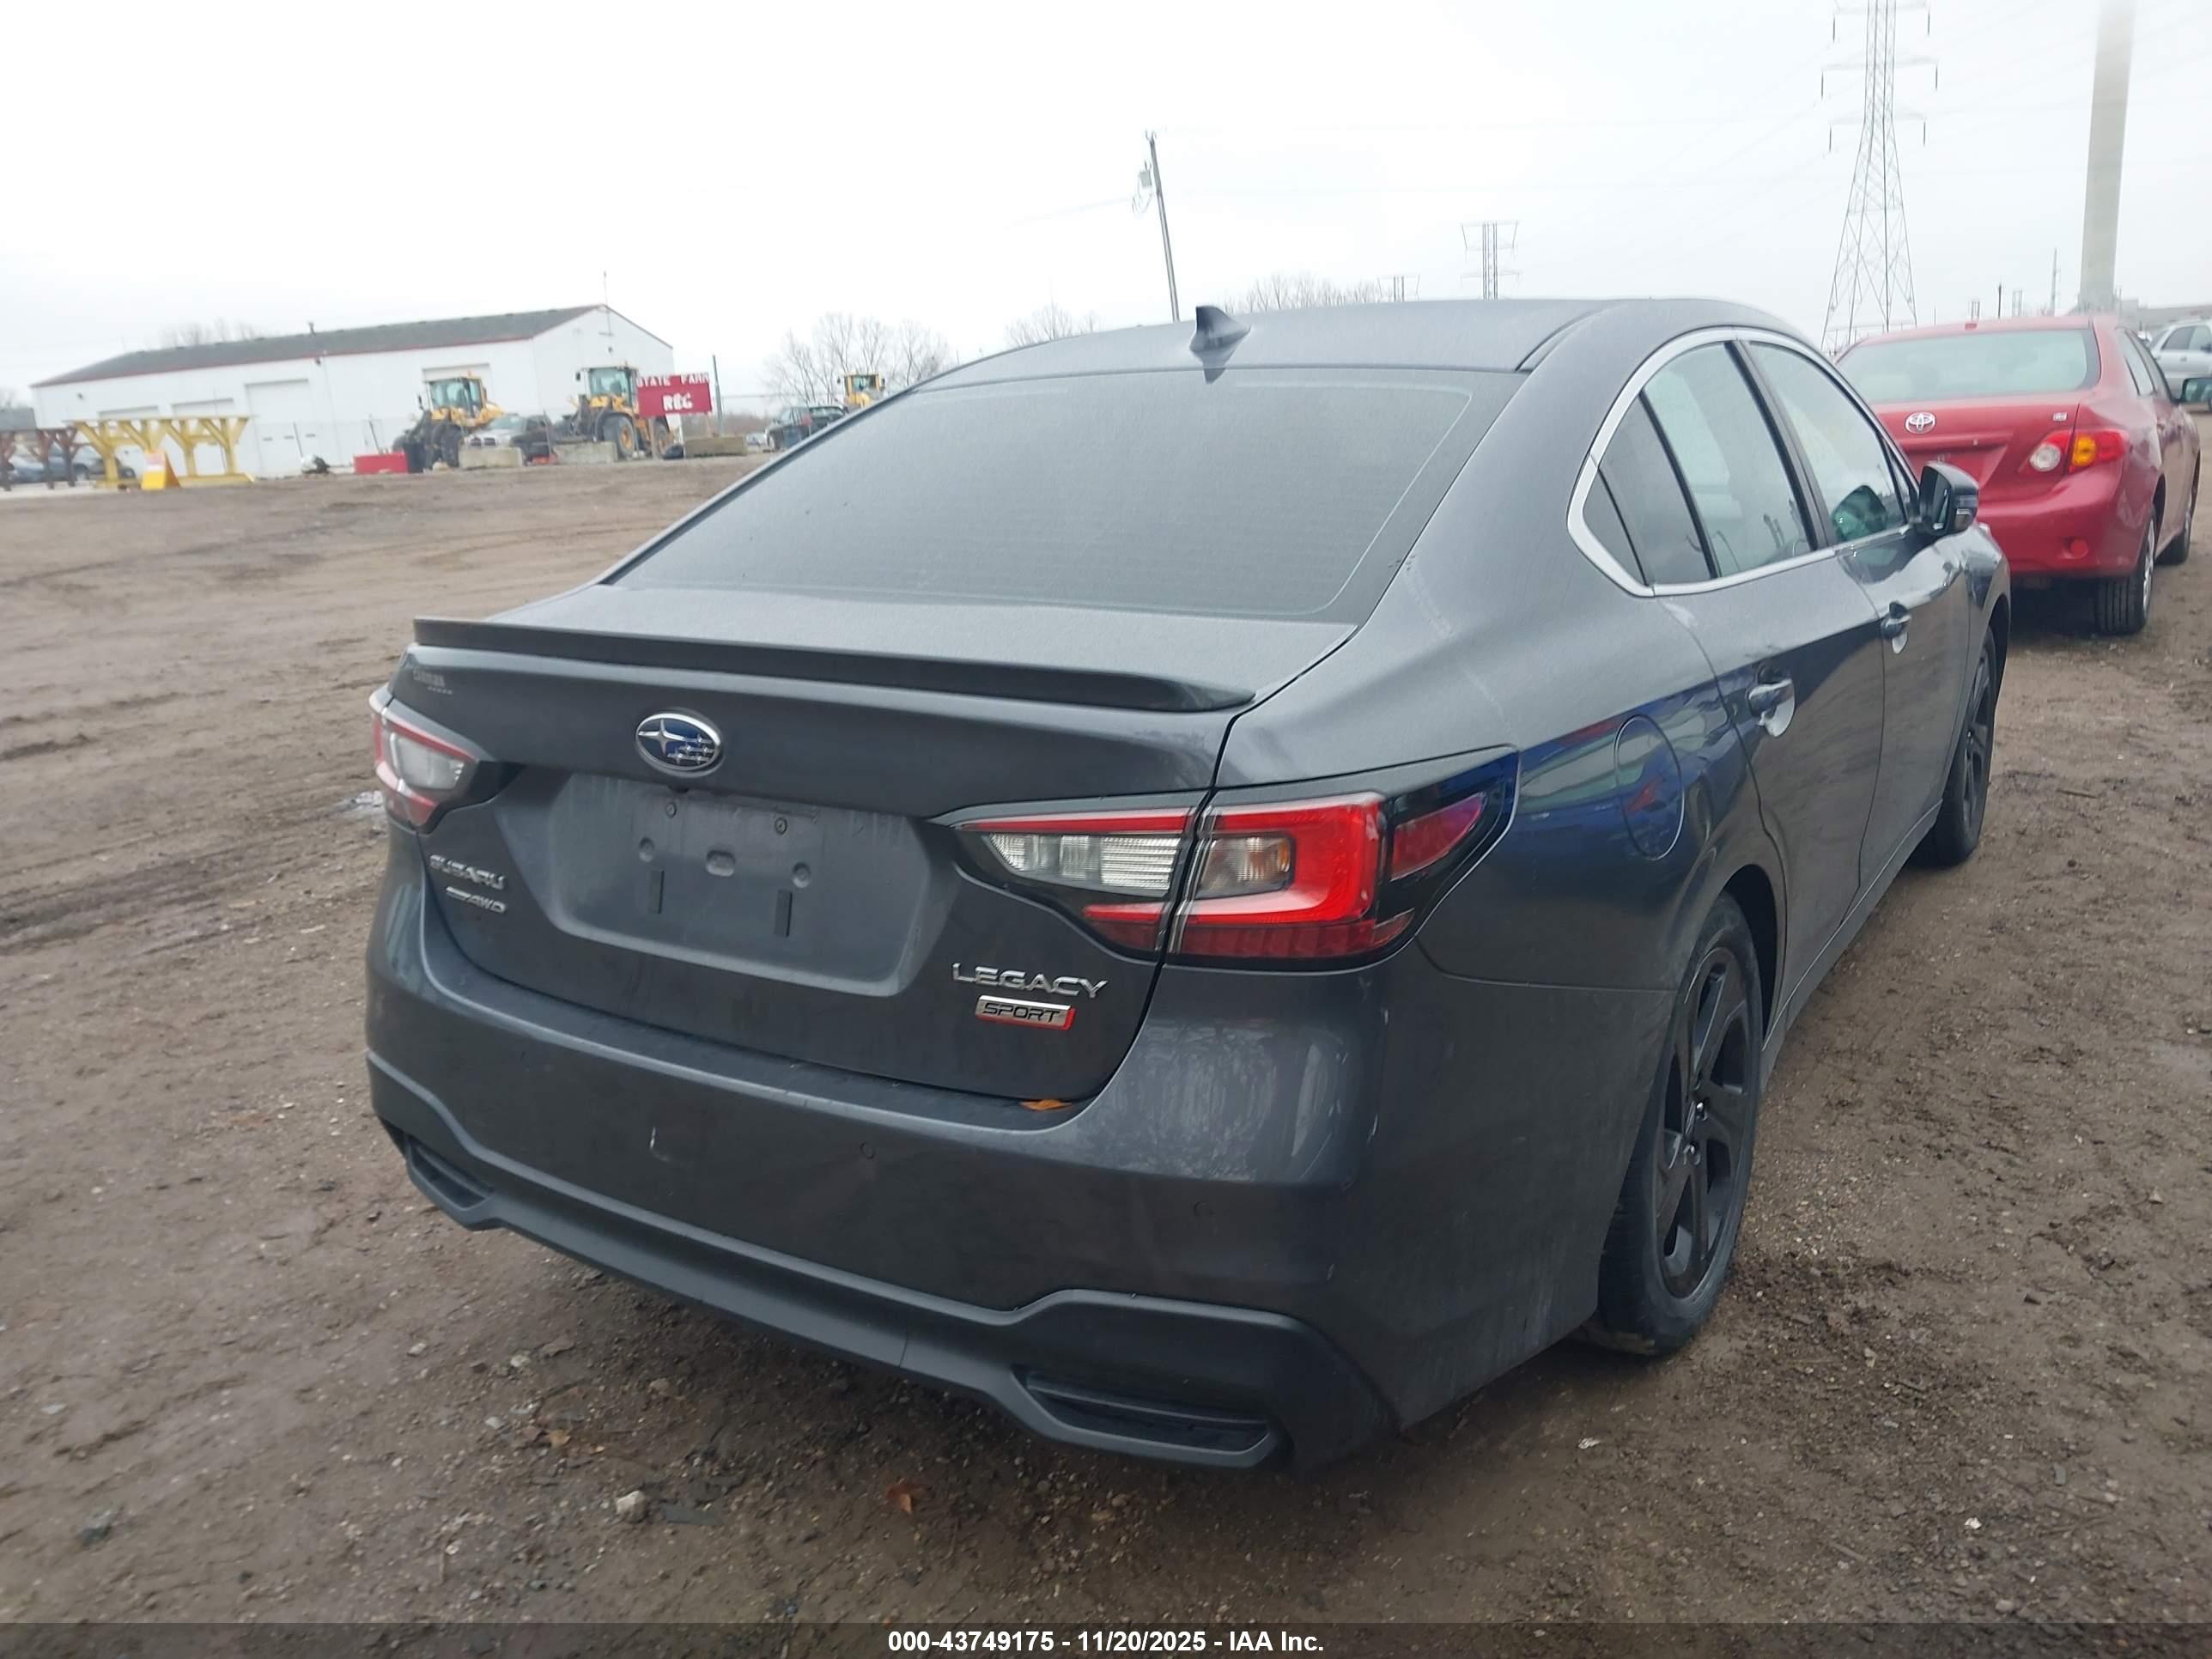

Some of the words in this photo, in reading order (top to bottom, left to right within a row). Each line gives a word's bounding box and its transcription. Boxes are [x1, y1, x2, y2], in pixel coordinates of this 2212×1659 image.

[636, 375, 671, 387] STATE
[429, 854, 504, 890] SUBARU
[952, 962, 1108, 999] LEGACY
[982, 1001, 1060, 1023] SPORT
